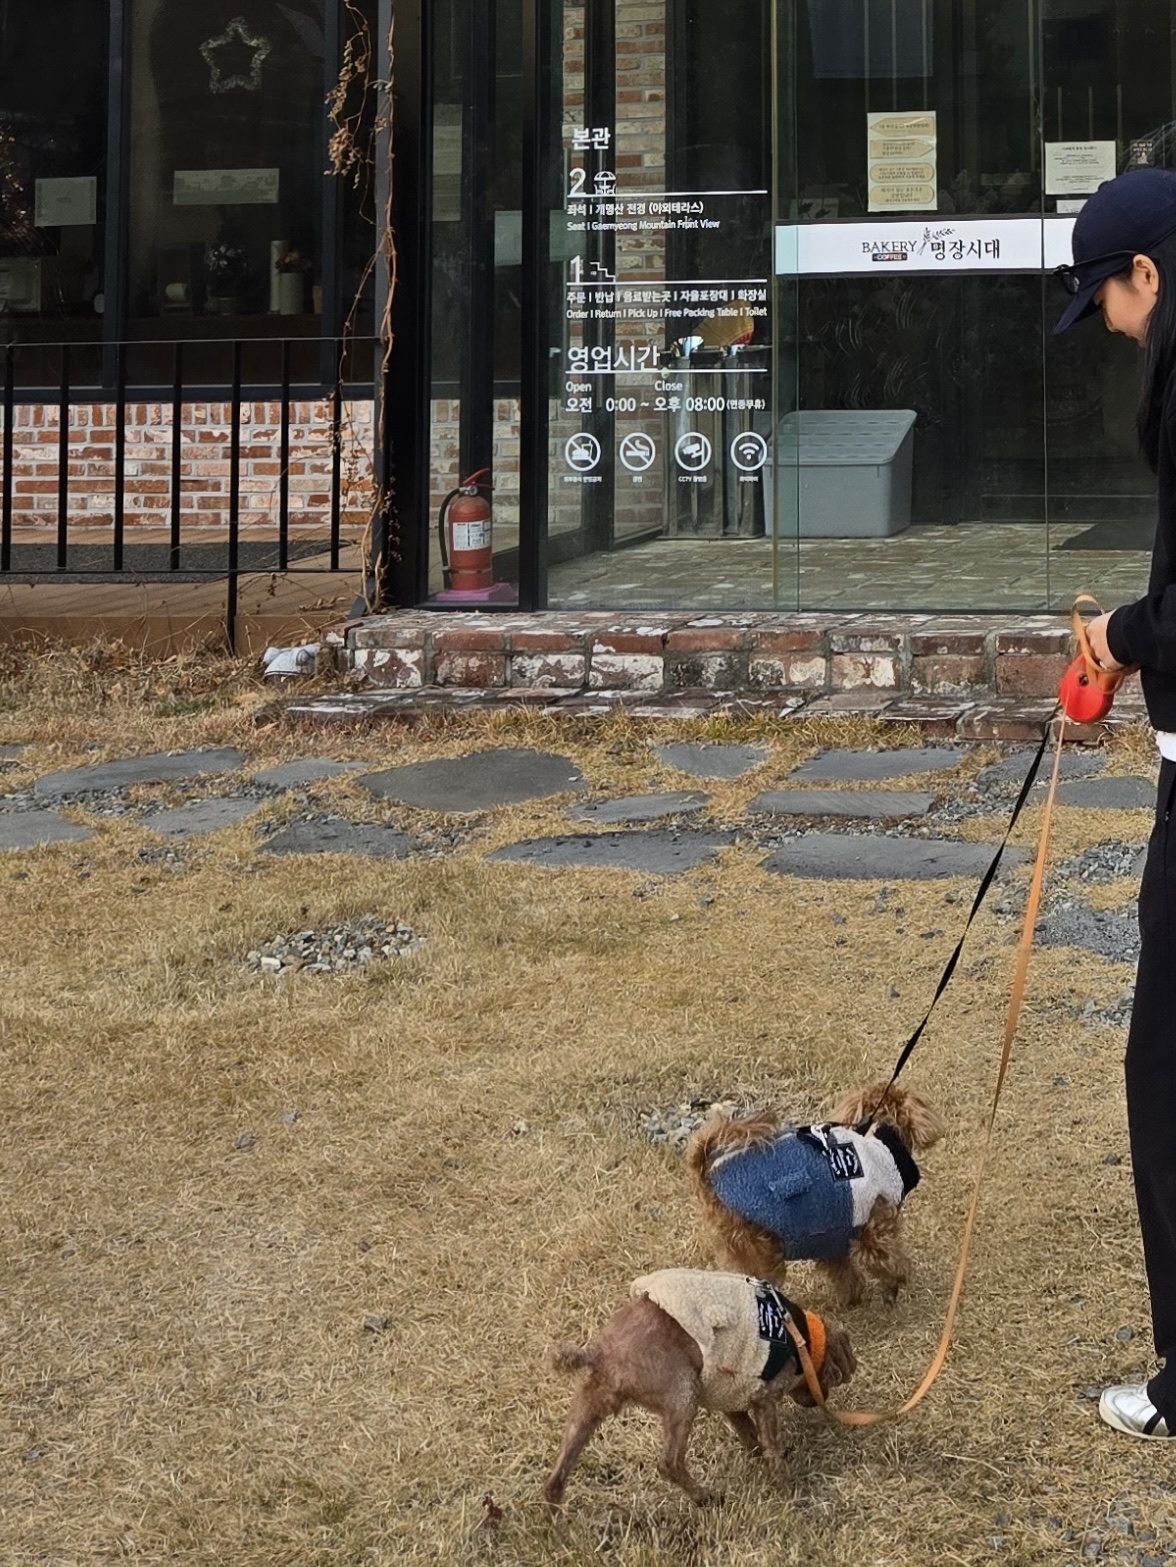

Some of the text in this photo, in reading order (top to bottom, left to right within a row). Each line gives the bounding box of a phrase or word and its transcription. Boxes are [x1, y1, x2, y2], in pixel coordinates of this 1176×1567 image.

[572, 127, 611, 150] 본관
[569, 168, 587, 195] 2
[567, 203, 587, 216] 좌석
[567, 222, 586, 231] Seat
[639, 220, 676, 230] Mountain
[700, 219, 720, 229] View
[862, 240, 917, 253] BAKERY
[930, 239, 1000, 261] 명장시대
[595, 291, 614, 304] 반납
[738, 289, 766, 301] 화장실
[566, 307, 767, 319] Order Return Pick Up Free Packing Table Toilet
[568, 346, 660, 372] 영업시간
[566, 380, 683, 393] Open Close
[565, 397, 592, 413] 오전
[653, 396, 681, 412] 오후
[686, 397, 725, 412] 08:00
